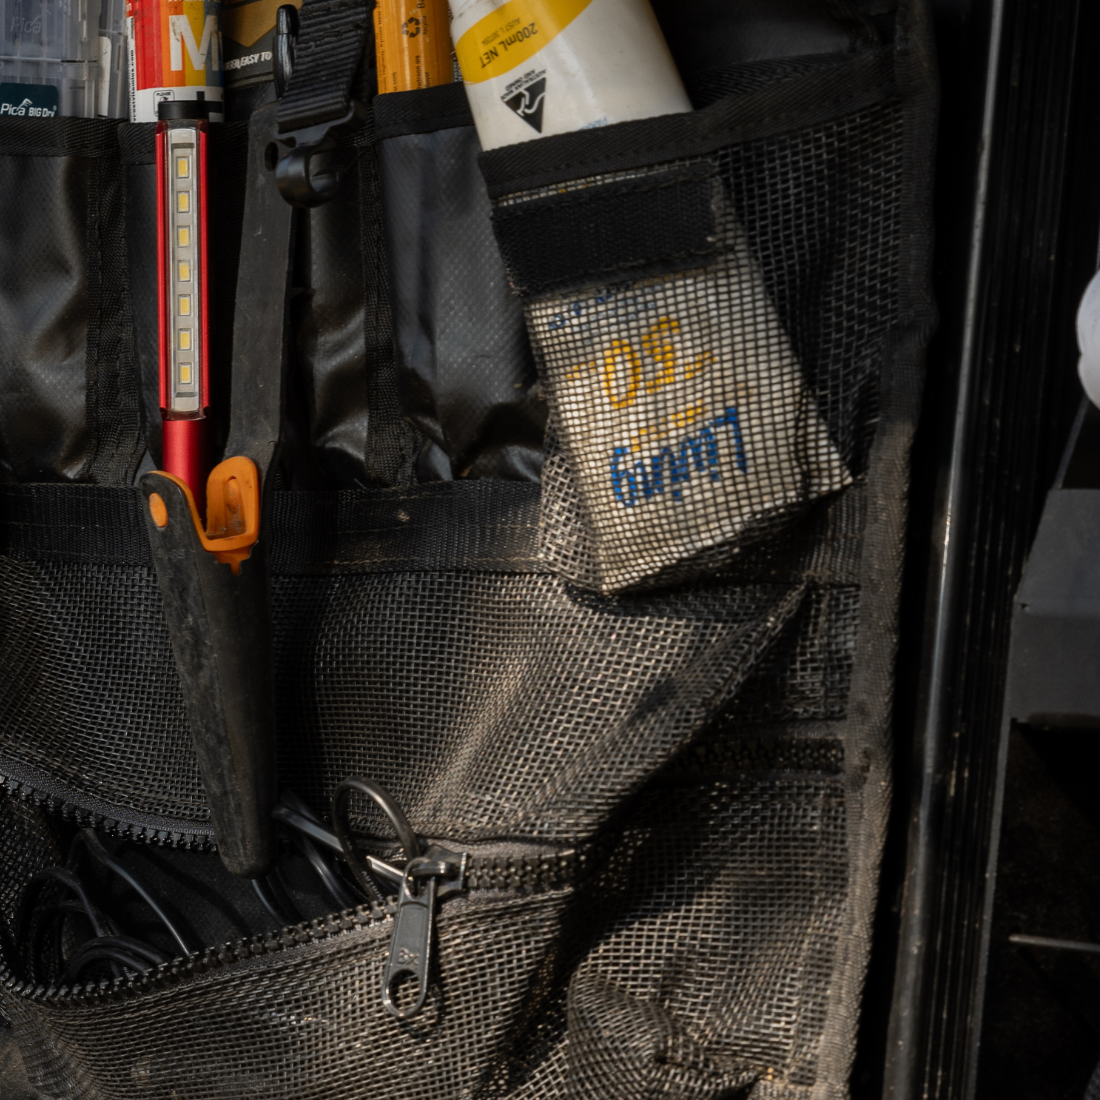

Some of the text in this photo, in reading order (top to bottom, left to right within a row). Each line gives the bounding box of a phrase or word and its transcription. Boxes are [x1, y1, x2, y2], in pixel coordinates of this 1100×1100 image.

[169, 14, 222, 72] M
[479, 22, 538, 69] 200mL NET
[0, 101, 26, 116] Pica
[28, 106, 42, 117] BIG
